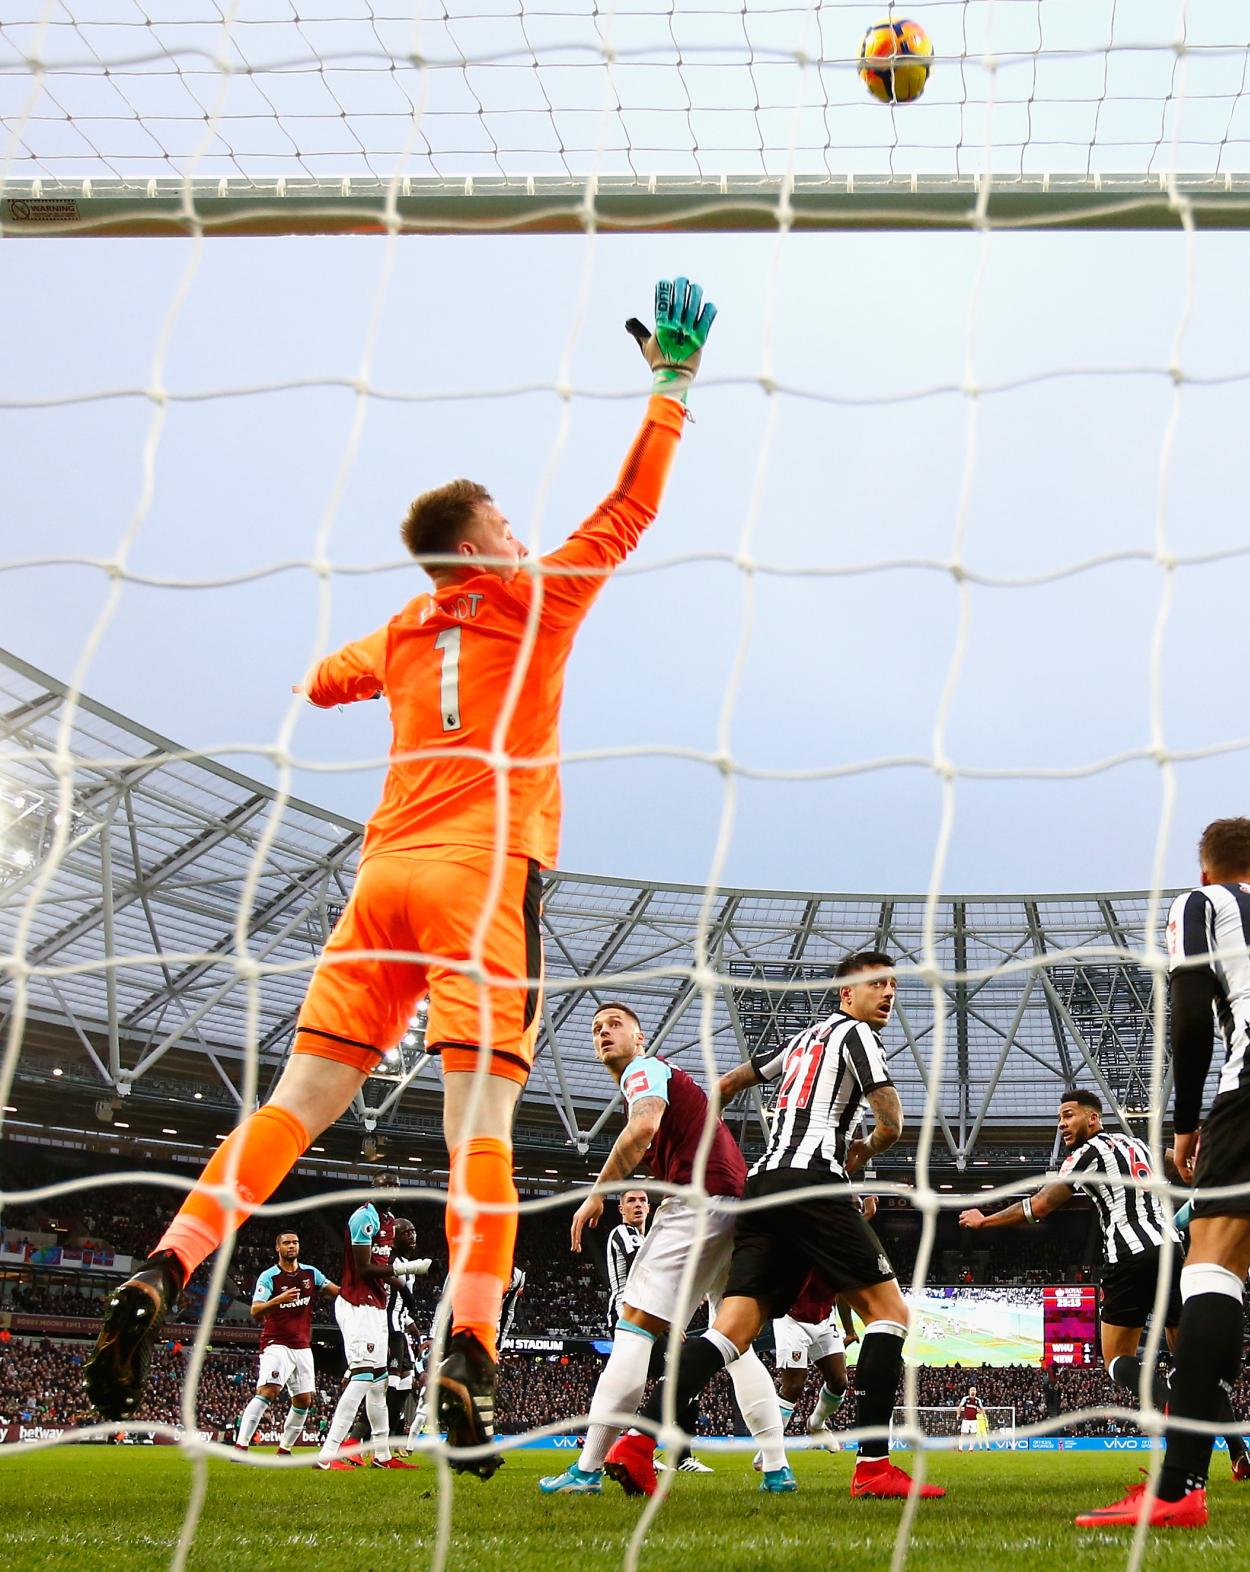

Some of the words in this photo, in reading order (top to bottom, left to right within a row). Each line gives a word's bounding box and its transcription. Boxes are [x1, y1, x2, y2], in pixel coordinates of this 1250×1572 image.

[434, 624, 462, 732] 1
[777, 1041, 824, 1109] 21
[1129, 1147, 1154, 1192] 6
[515, 1340, 564, 1351] STADIUM
[1051, 1343, 1074, 1353] WHU
[1084, 1343, 1091, 1353] 1
[1084, 1354, 1091, 1364] 1
[20, 1426, 64, 1440] betway
[1104, 1437, 1137, 1449] vivo
